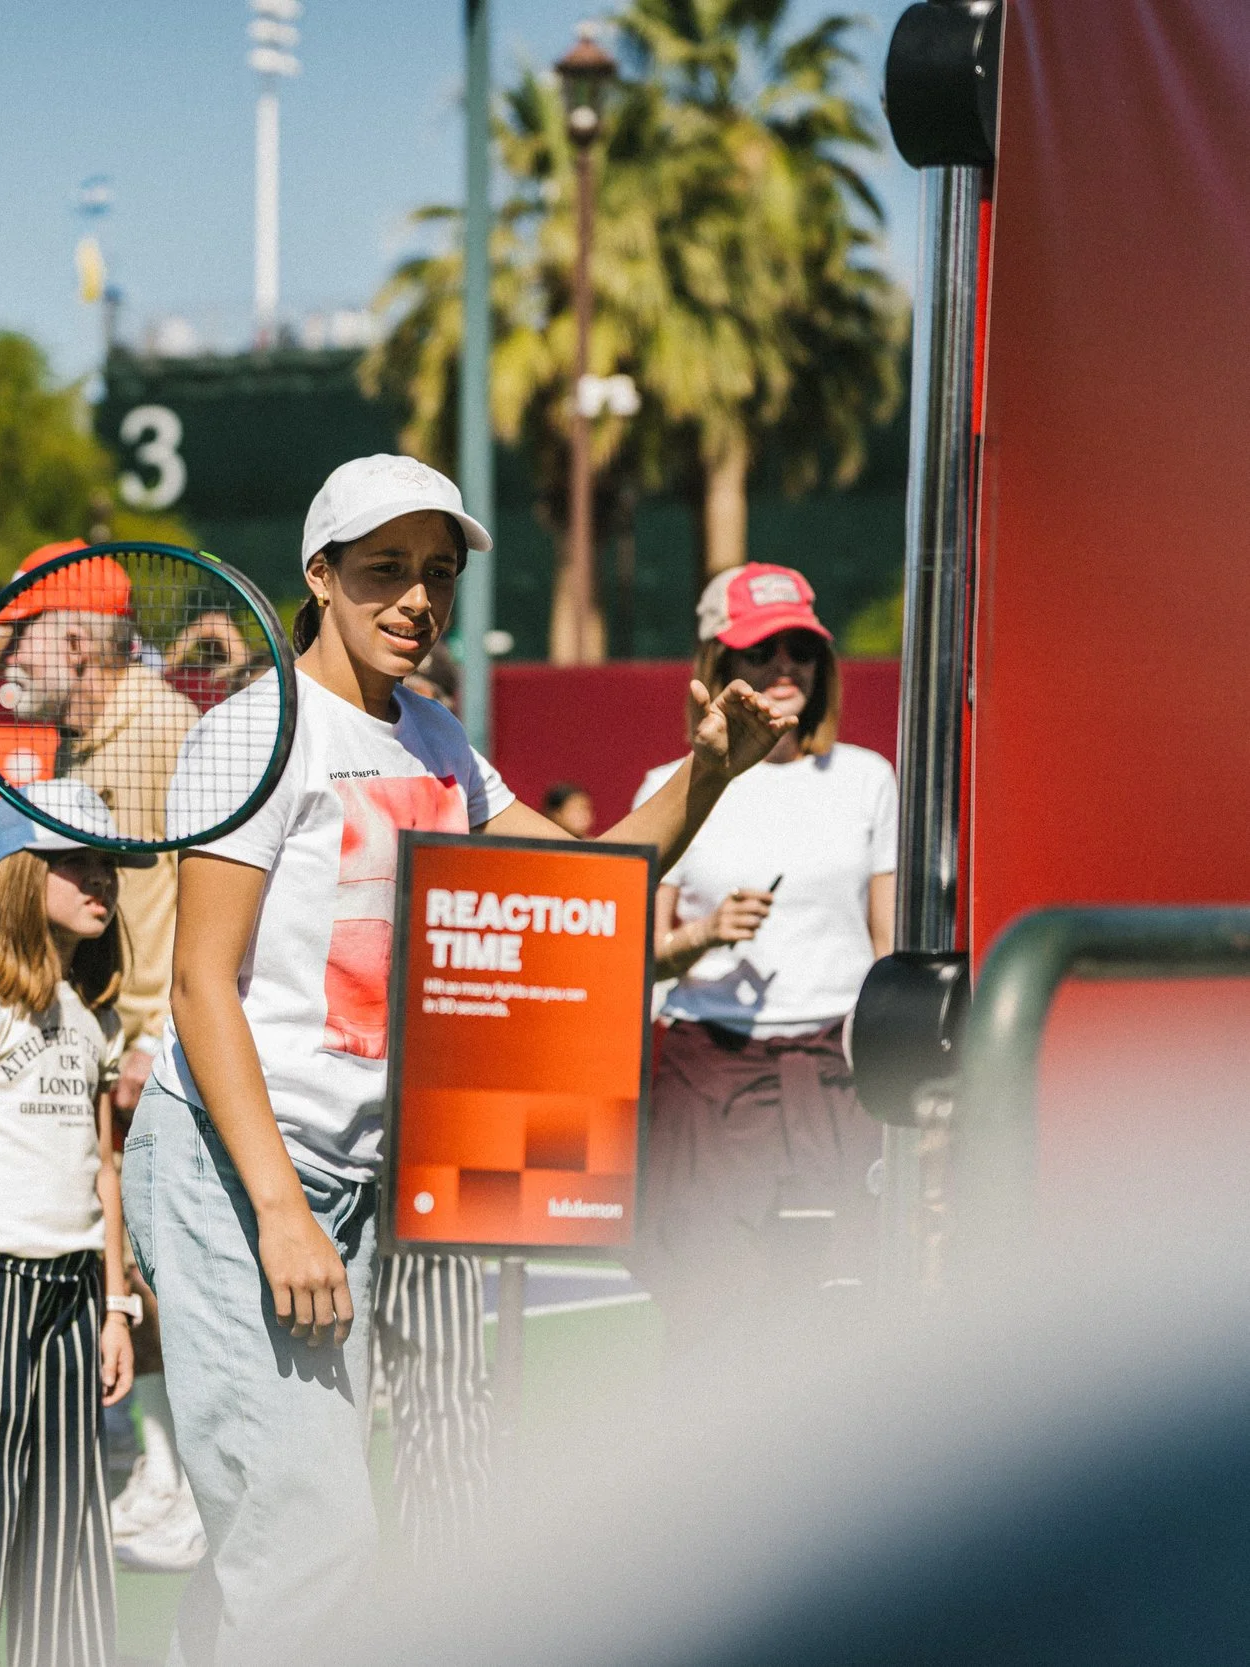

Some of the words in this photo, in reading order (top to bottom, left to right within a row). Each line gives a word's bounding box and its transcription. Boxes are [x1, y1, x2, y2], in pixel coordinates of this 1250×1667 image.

[119, 404, 187, 509] 3
[426, 888, 616, 937] REACTION
[426, 930, 523, 972] TIME
[1, 1027, 79, 1081] ATHLETIC
[60, 1055, 81, 1070] UK
[19, 1103, 83, 1116] GREENWICH
